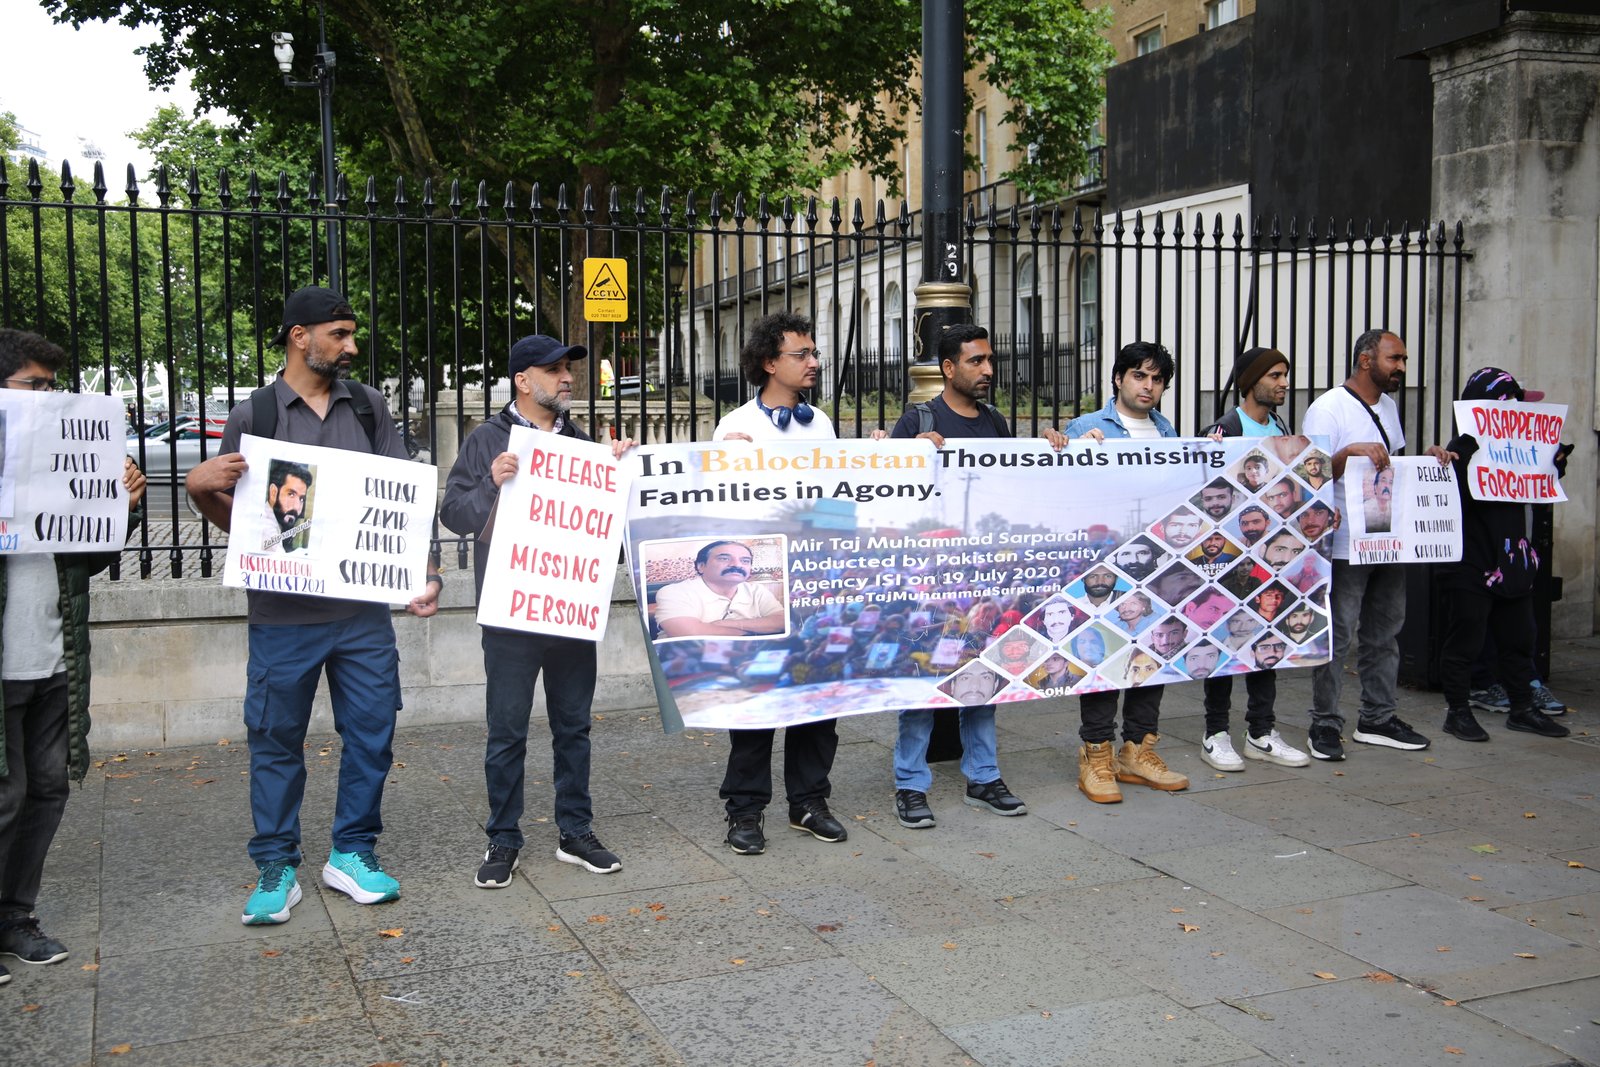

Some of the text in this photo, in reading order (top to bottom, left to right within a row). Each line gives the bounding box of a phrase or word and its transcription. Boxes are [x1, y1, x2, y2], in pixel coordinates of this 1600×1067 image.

[946, 243, 957, 258] 2
[948, 262, 957, 276] 9
[61, 418, 111, 441] RELEASE
[1472, 407, 1563, 445] DISAPPEARED
[50, 453, 100, 473] JAVED
[637, 446, 1226, 477] In Balochistan Thousands missing
[1488, 441, 1513, 464] but
[530, 448, 616, 493] RELEASE
[1417, 466, 1452, 482] RELEASE
[1476, 465, 1558, 500] FORGOTTEN
[69, 478, 118, 499] SHAMS
[365, 477, 419, 504] RELEASE
[640, 480, 942, 507] Families in Agony.
[32, 512, 116, 543] SARPARAH
[359, 506, 409, 531] ZAKIR
[529, 494, 613, 540] BALOCH
[0, 534, 19, 550] 021
[355, 529, 407, 554] AHMED
[790, 529, 1089, 553] Mir Taj Muhammad Sarparah
[510, 543, 600, 584] MISSING
[790, 547, 1101, 573] Abducted by Pakistan Security
[241, 572, 325, 594] 30 AUGUST 2021
[339, 559, 414, 591] SARPARAH
[791, 566, 1061, 595] Agency ISI on 19 July 2020
[791, 582, 1062, 609] #ReleaseTajMuhammadSarparah
[509, 590, 600, 631] PERSONS
